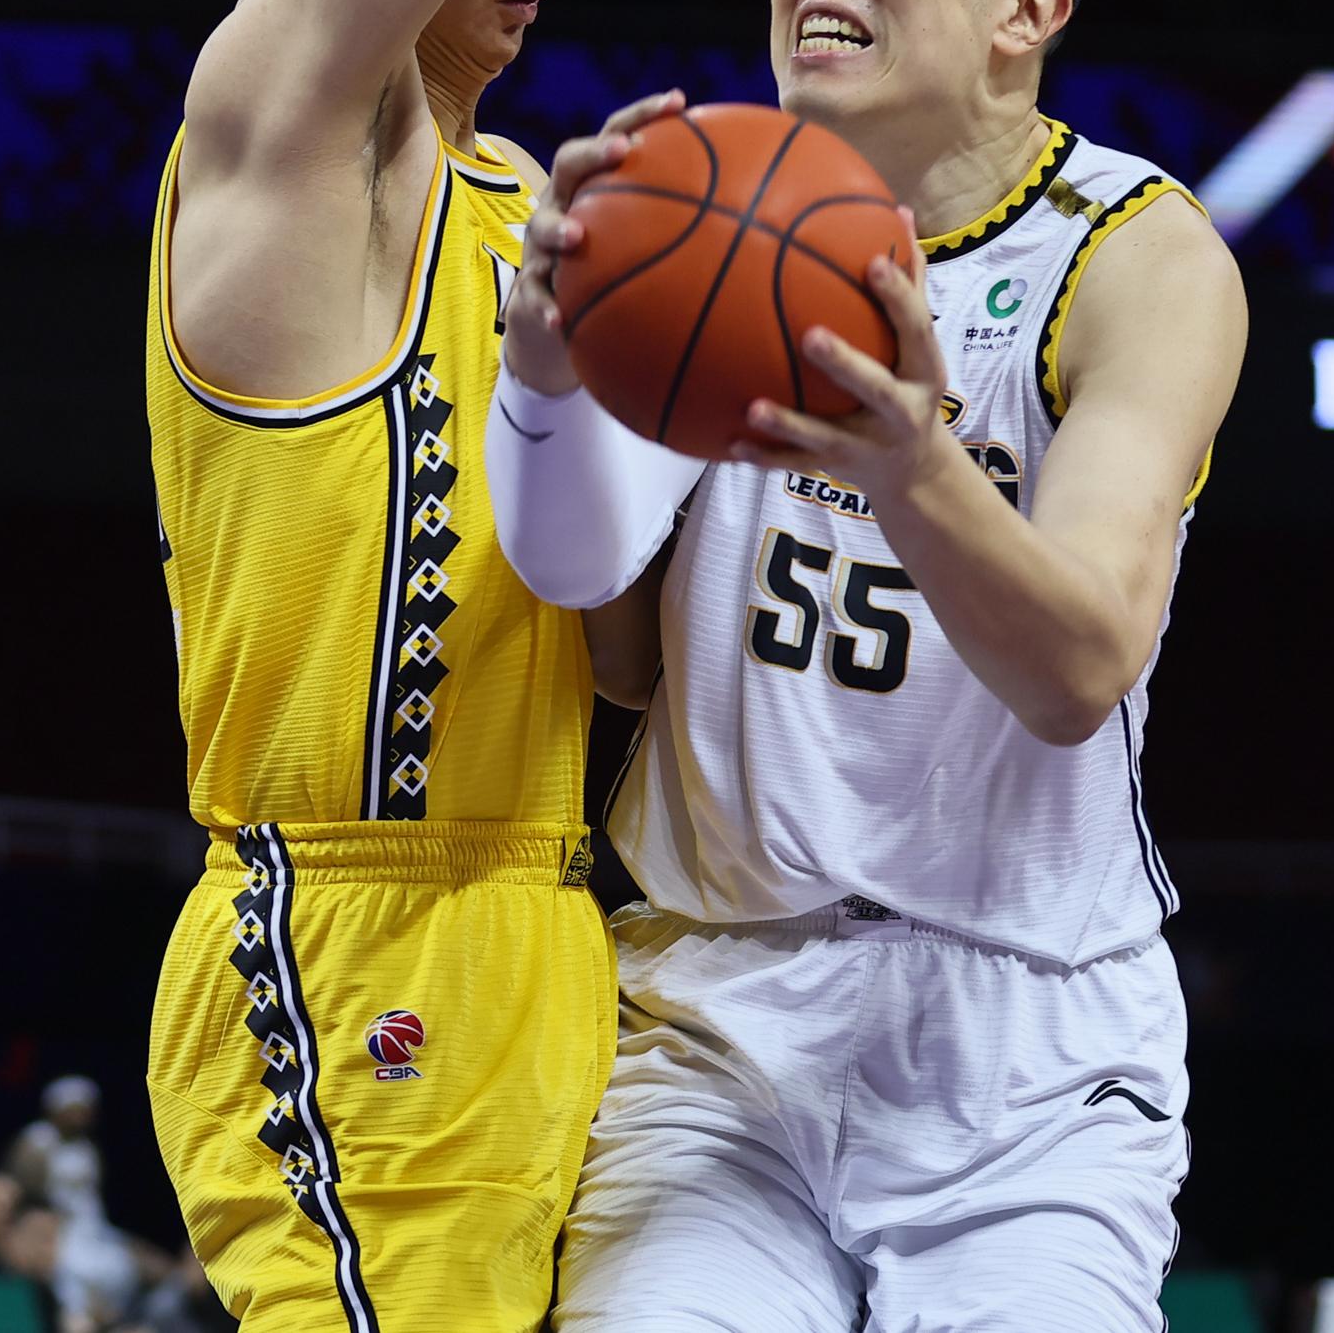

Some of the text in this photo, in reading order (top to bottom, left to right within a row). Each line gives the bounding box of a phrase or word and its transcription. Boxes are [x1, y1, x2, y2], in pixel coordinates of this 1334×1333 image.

[963, 340, 1014, 352] CHINA LIFE
[746, 527, 917, 694] 55
[374, 1066, 423, 1082] CBA
